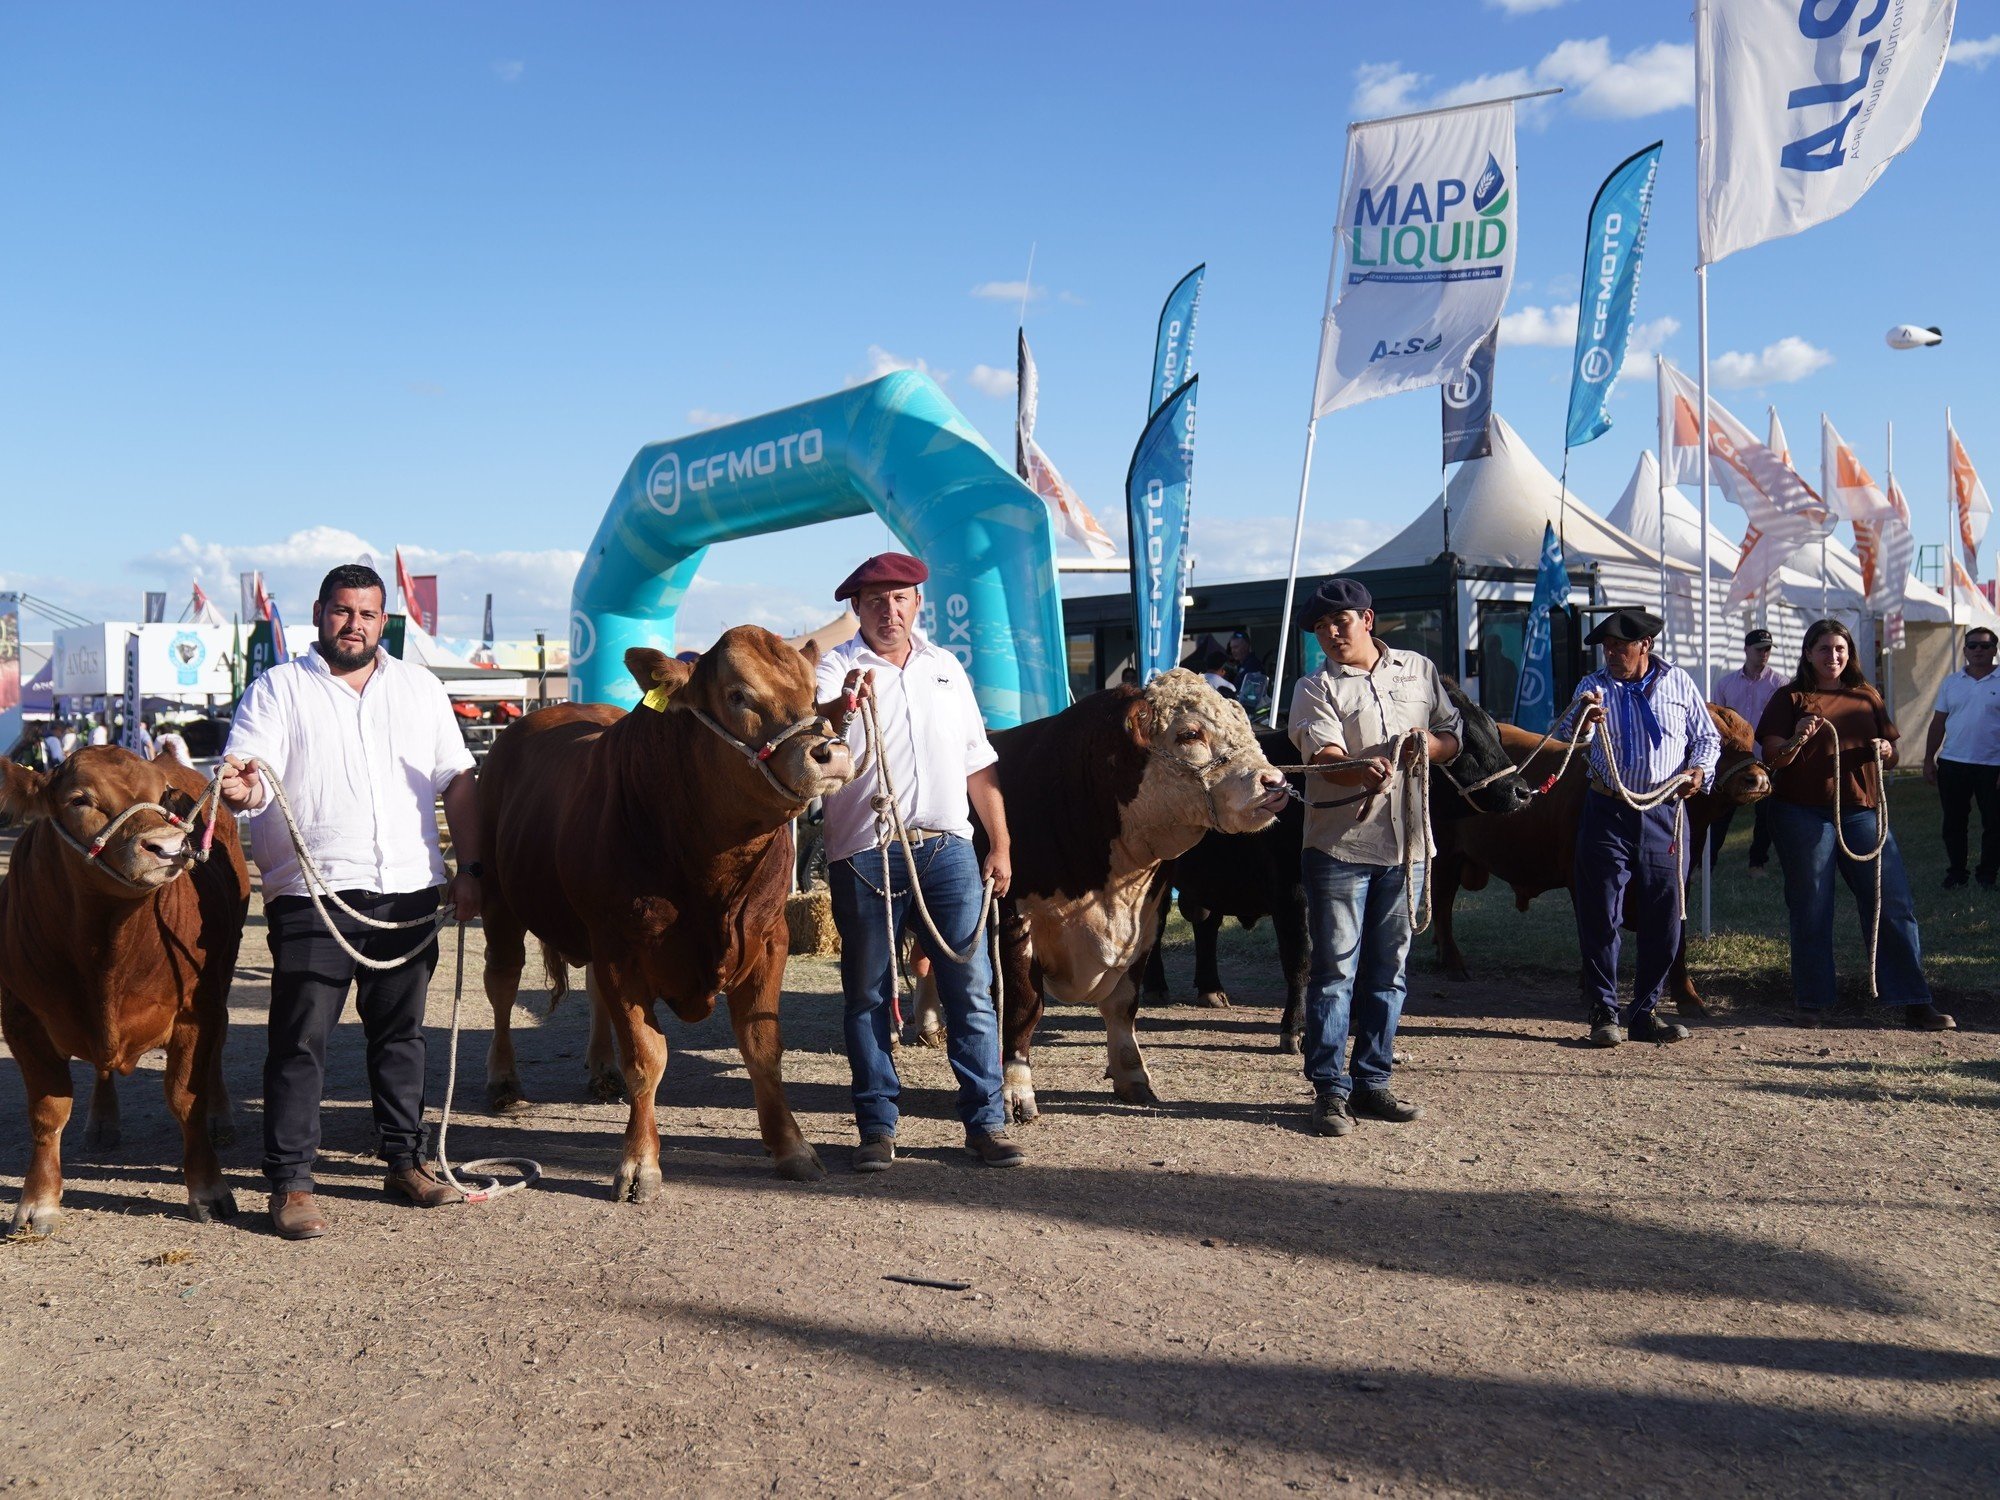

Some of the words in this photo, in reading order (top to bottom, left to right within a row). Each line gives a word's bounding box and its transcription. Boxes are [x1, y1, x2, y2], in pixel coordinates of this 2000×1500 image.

[1781, 0, 1890, 172] ALS
[1850, 127, 1864, 159] AGRI
[1863, 79, 1885, 125] LIQUID
[1877, 0, 1905, 75] SOLUTIONS
[1352, 218, 1507, 269] LIQUID
[1353, 179, 1466, 226] MAP
[1593, 213, 1622, 340] CFMOTO
[1162, 320, 1181, 402] FMOTO
[687, 428, 823, 491] CFMOTO
[1147, 478, 1164, 656] CFMOTO
[66, 645, 98, 675] ANGUS
